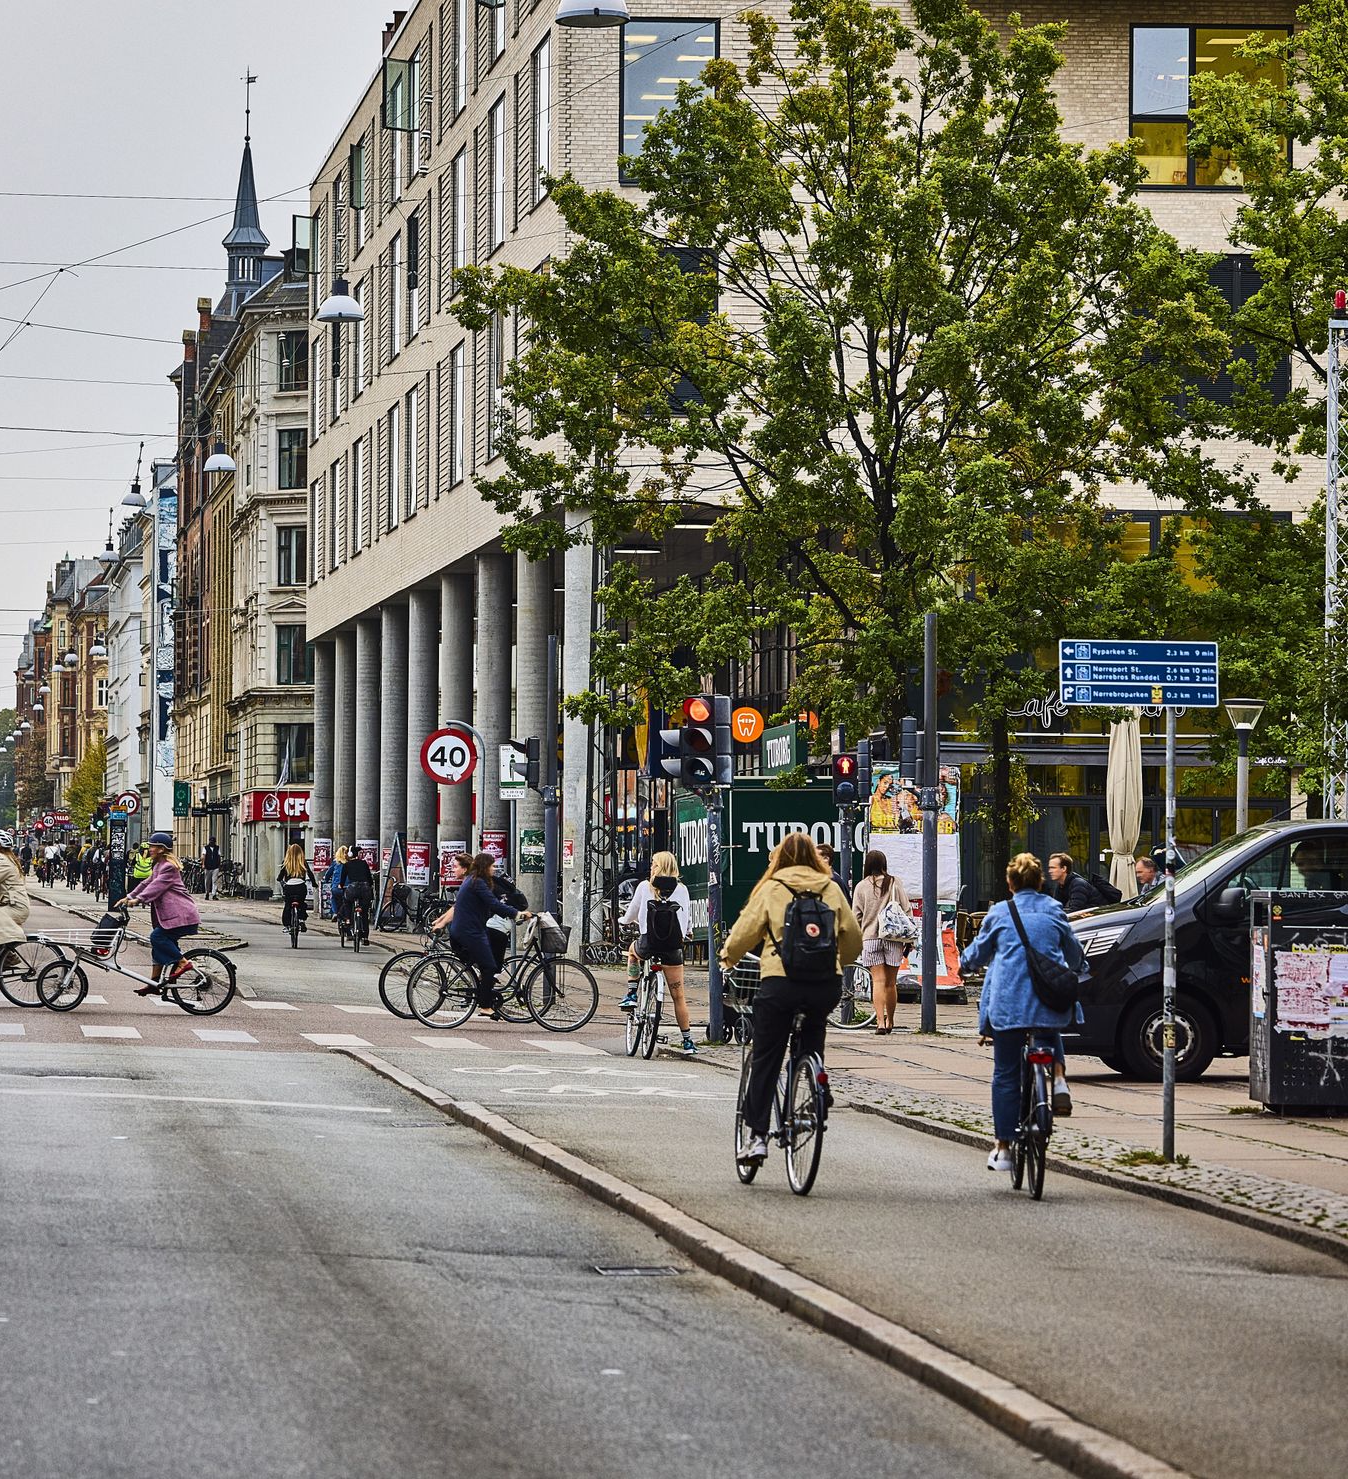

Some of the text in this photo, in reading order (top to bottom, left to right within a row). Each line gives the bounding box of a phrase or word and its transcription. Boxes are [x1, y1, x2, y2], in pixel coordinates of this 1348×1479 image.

[1092, 648, 1125, 656] Ryparken
[1128, 648, 1139, 656] St.
[1092, 666, 1128, 674] Nørreport
[1092, 691, 1149, 699] Nørrebroparken
[430, 746, 466, 767] 40
[766, 735, 791, 769] TUBORG
[119, 799, 134, 809] 40
[679, 817, 709, 867] TUBOR
